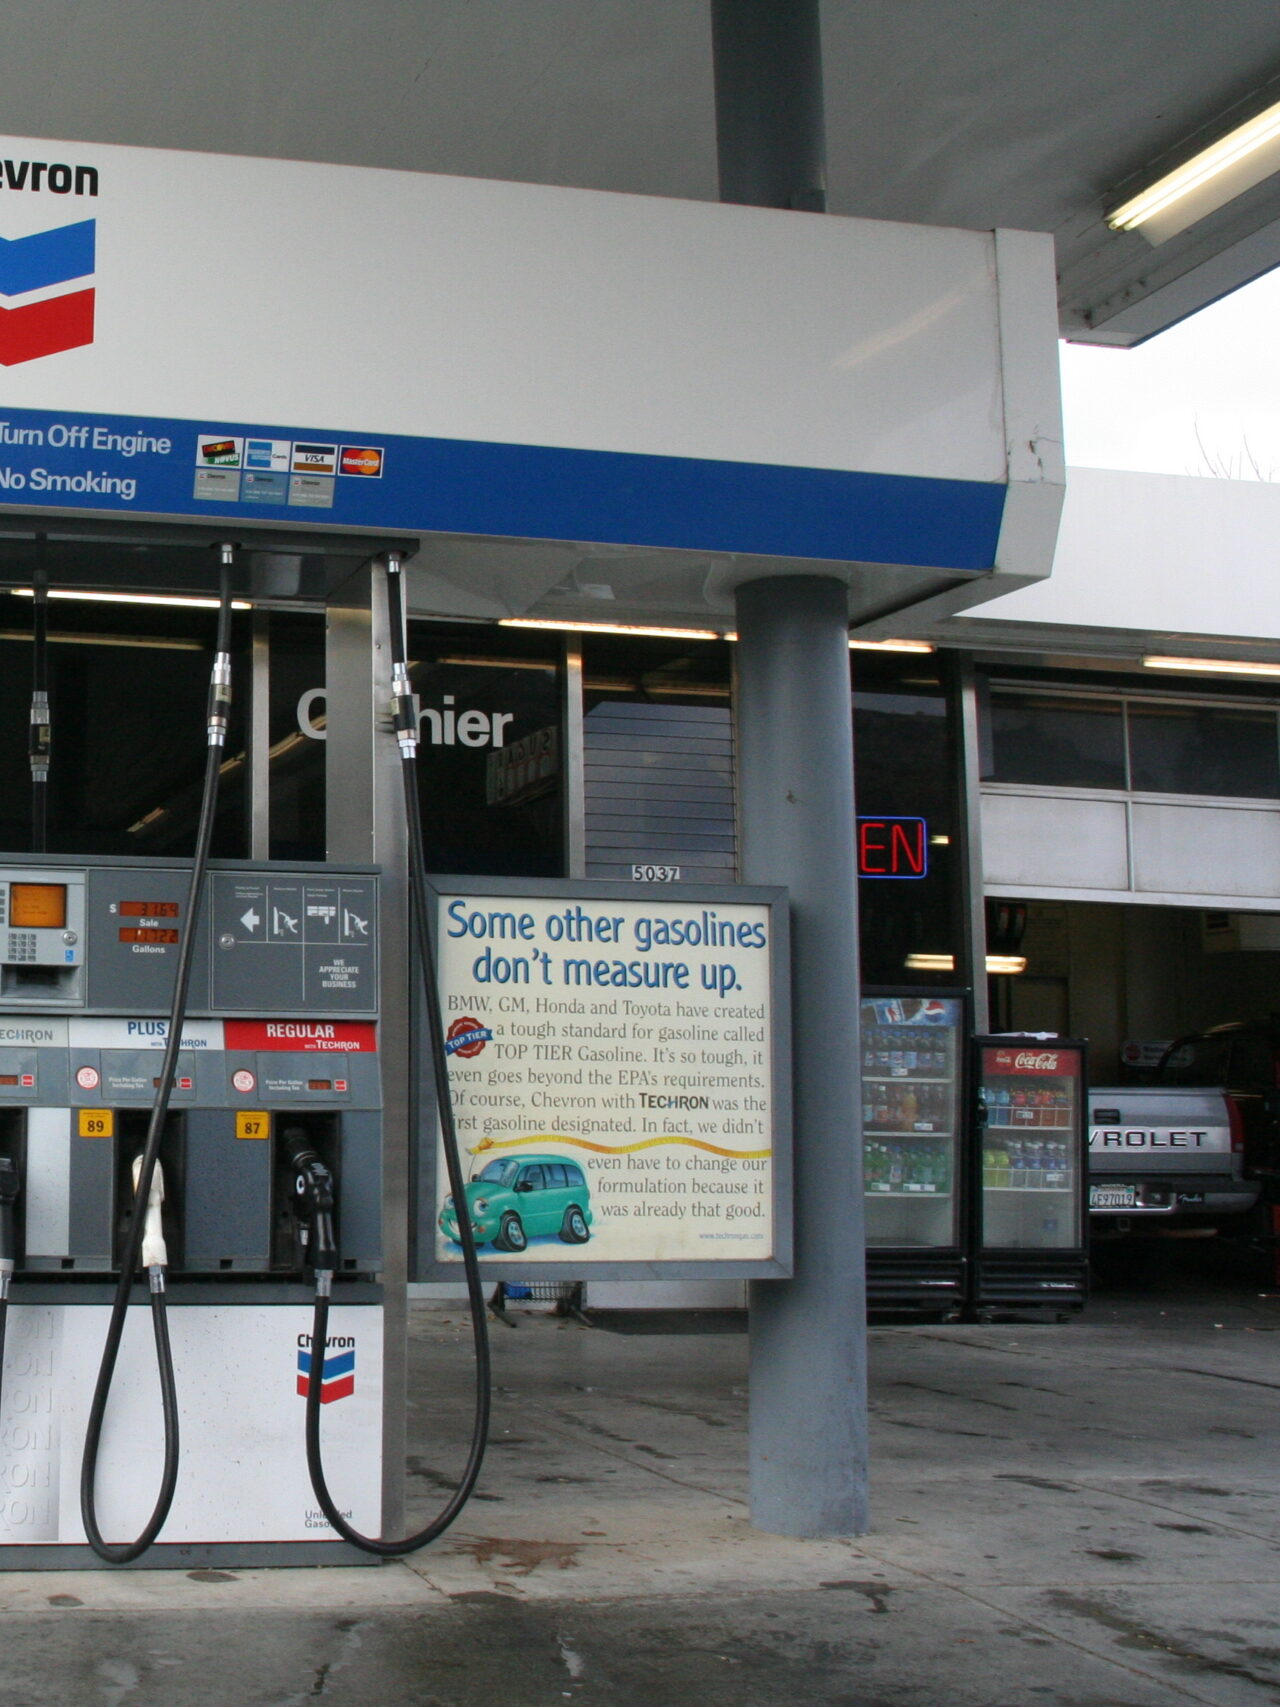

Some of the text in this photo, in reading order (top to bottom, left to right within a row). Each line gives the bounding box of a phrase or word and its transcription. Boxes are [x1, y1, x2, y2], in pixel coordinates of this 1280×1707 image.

[47, 424, 89, 448] Off
[92, 428, 171, 457] Engine
[304, 454, 325, 463] VISA
[342, 457, 380, 467] MasterCard
[30, 467, 136, 500] Smoking
[297, 688, 513, 748] Chier
[861, 822, 923, 872] EN
[634, 866, 678, 881] 5037
[139, 918, 159, 927] Sale
[447, 900, 766, 952] Some other gasolines
[132, 945, 166, 954] Gallons
[319, 966, 359, 974] APPRECIATE
[330, 973, 349, 981] YOUR
[473, 946, 742, 999] don't measure up.
[448, 995, 765, 1019] BMW, GM, Honda and Toyota have created
[127, 1021, 166, 1036] PLUS
[266, 1023, 335, 1038] REGULAR
[496, 1021, 765, 1042] a tough standard for gasoline called
[162, 1037, 207, 1048] THRON
[316, 1039, 360, 1051] TECHRON
[448, 1030, 488, 1049] TOP TIER
[494, 1043, 763, 1067] TOP TIER Gasoline. It's so tough, it
[448, 1068, 765, 1089] even goes beyond the EPA's requirements.
[470, 1095, 525, 1108] course,
[531, 1091, 596, 1108] Chevron
[602, 1093, 635, 1109] with
[639, 1092, 709, 1111] TECHRON
[713, 1100, 738, 1111] was
[743, 1096, 767, 1111] the
[87, 1120, 104, 1132] 89
[244, 1122, 260, 1134] 87
[453, 1114, 764, 1135] rst gasoline designated. In fact, we didn't
[1089, 1130, 1207, 1147] VROLET
[587, 1154, 767, 1173] even have to change our
[598, 1177, 764, 1194] formulation because it
[601, 1201, 766, 1220] was already that good.
[298, 1333, 355, 1348] Chvron
[305, 1510, 352, 1519] Unled
[305, 1520, 330, 1528] Gaso
